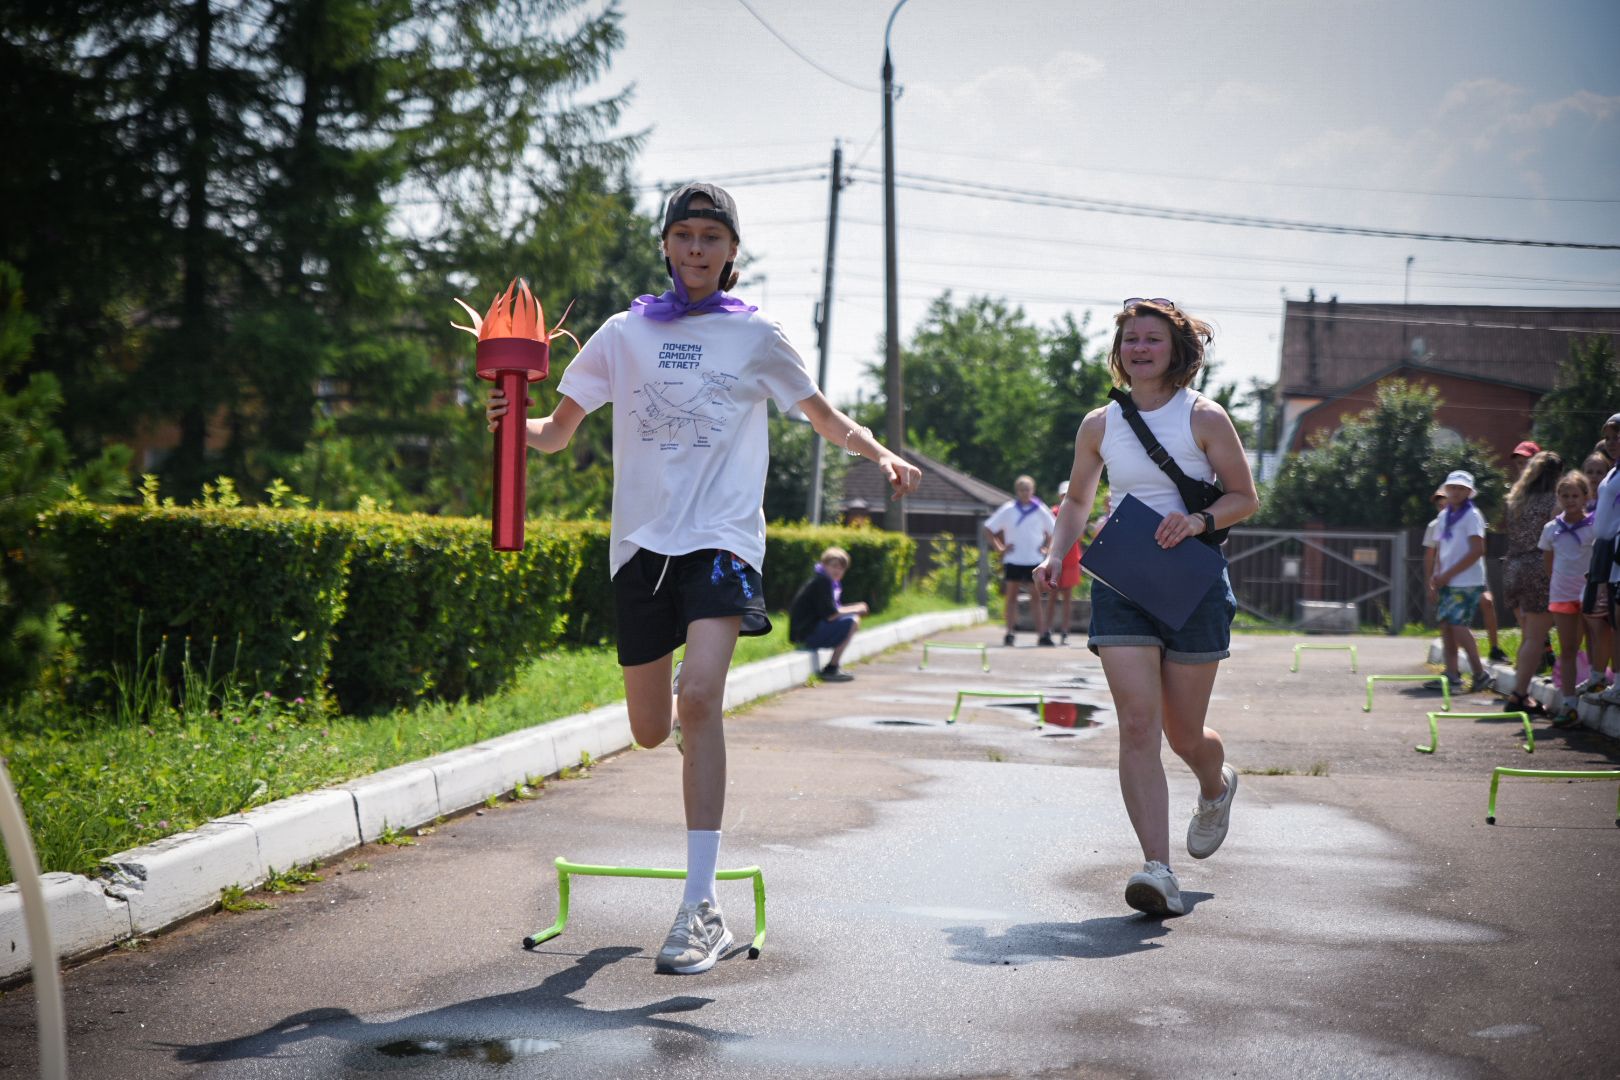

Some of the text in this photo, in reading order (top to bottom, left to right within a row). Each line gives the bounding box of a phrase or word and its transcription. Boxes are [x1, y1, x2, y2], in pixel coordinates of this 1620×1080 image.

[662, 343, 702, 352] ПОЧЕМУ
[658, 351, 703, 361] САМОЛЕТ
[658, 360, 700, 370] ЛЕТАЕТ?
